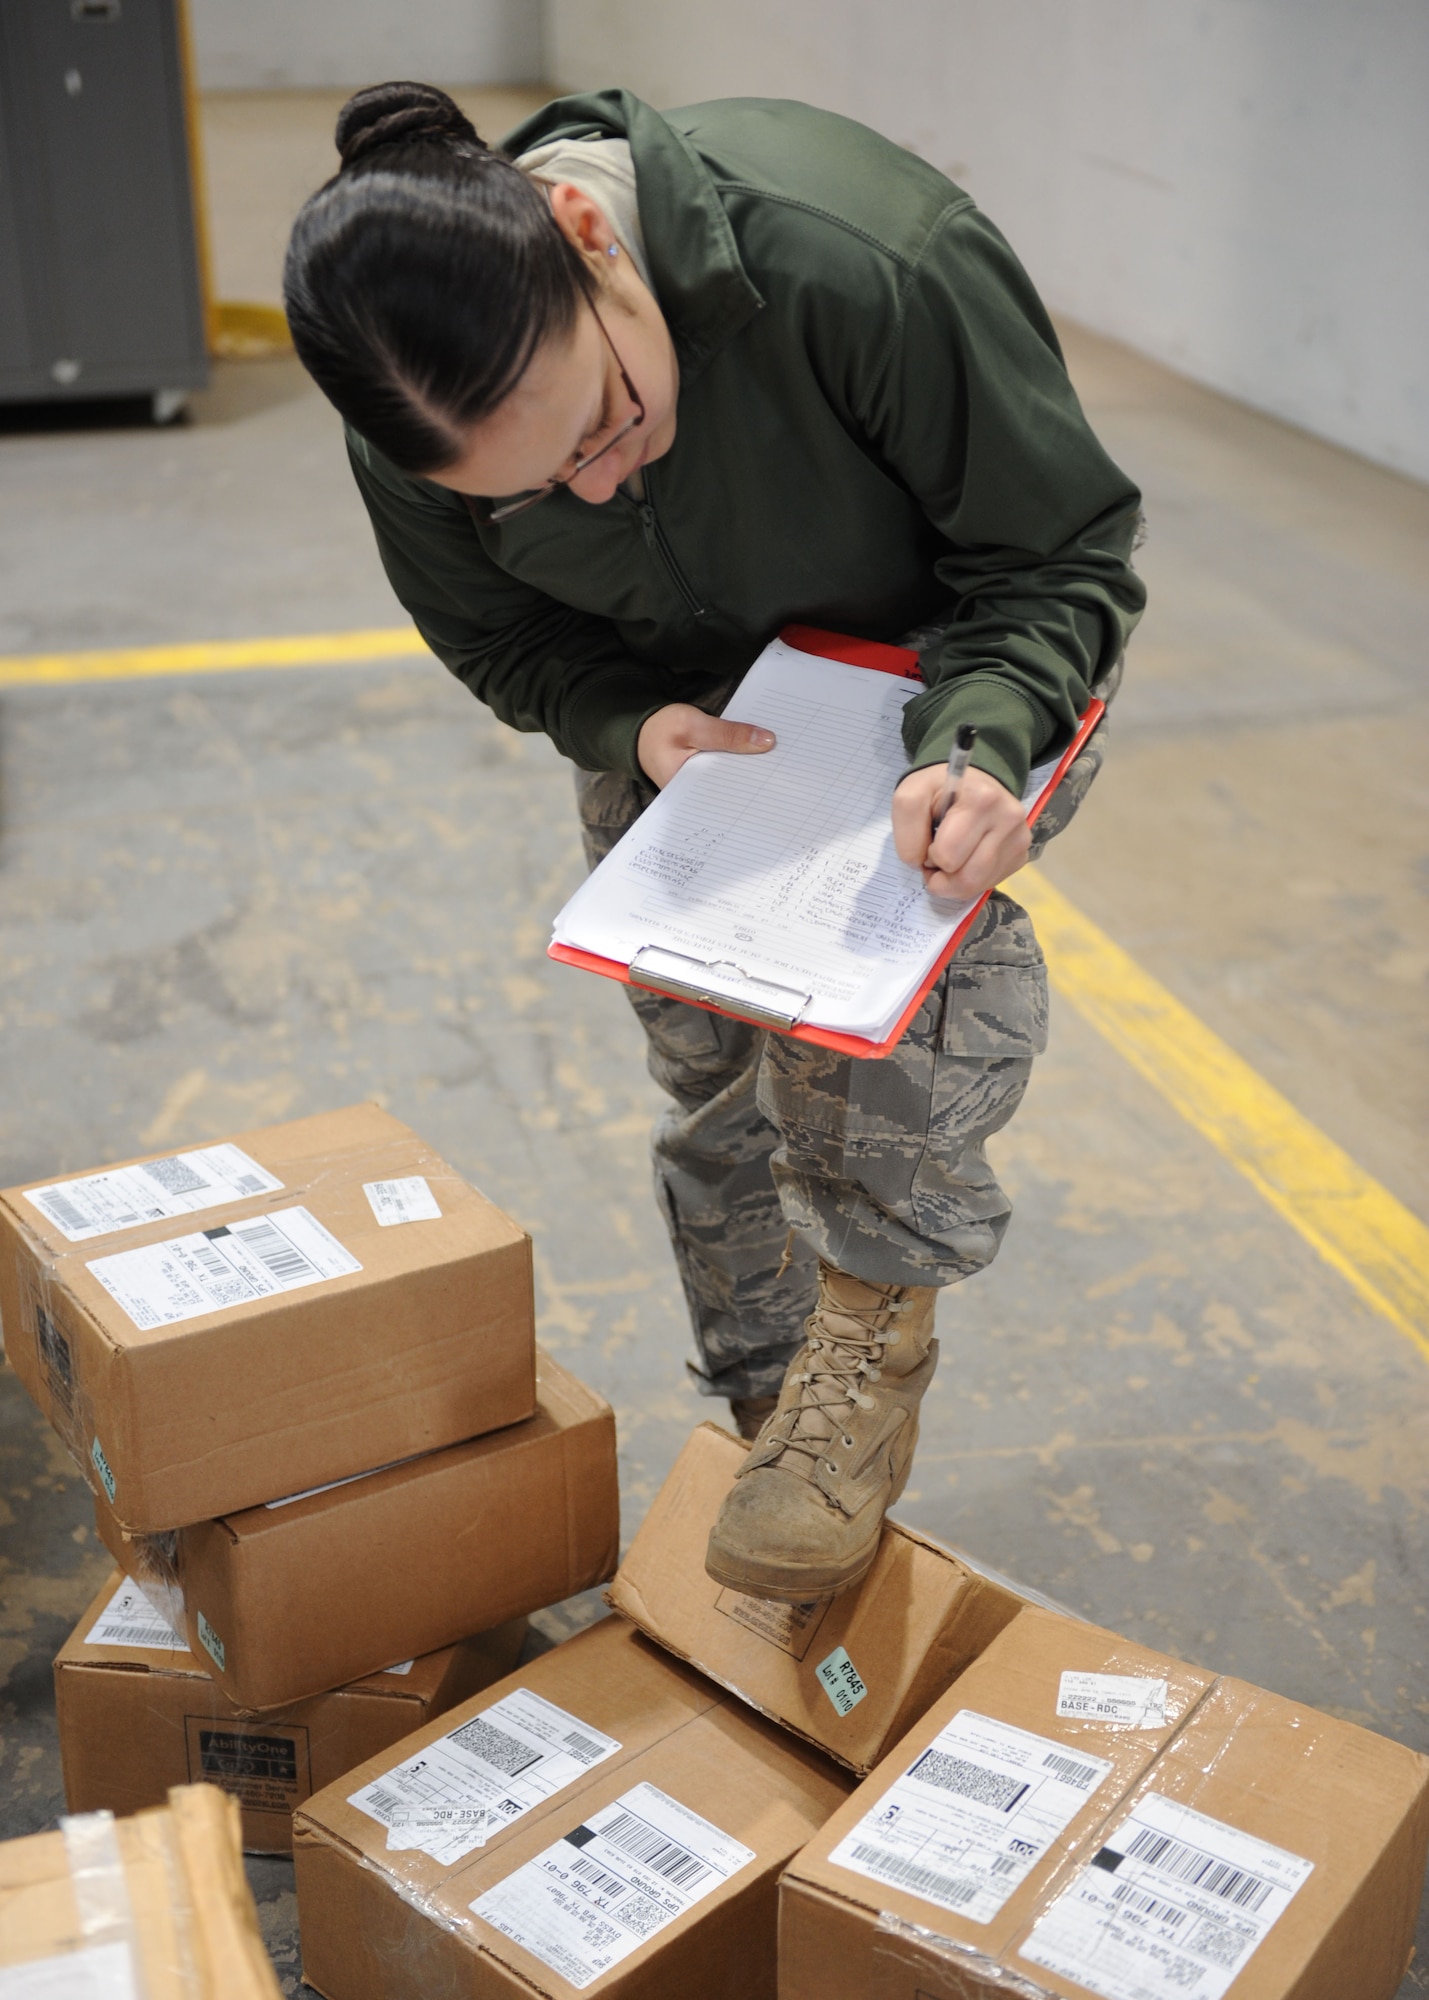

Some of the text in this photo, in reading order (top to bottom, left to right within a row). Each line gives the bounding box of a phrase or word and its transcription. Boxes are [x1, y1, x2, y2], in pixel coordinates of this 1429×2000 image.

[822, 1664, 835, 1681] Lot
[839, 1661, 864, 1695] R7845
[1061, 1700, 1118, 1714] BASE-RDC
[208, 1739, 288, 1756] AbilityOne
[1054, 1772, 1090, 1790] FB4661
[433, 1809, 485, 1819] BASE-RDC
[498, 1799, 523, 1815] DOV
[1010, 1839, 1039, 1856] DOV
[542, 1860, 610, 1909] TX 796 0-01
[546, 1885, 569, 1901] 79607
[630, 1876, 680, 1911] UPS GROUND
[569, 1901, 581, 1909] TX
[582, 1909, 597, 1921] AFB
[1080, 1890, 1176, 1940] TX 796 0-01
[1186, 1901, 1257, 1937] UPS GROUND
[498, 1922, 513, 1934] LBS
[598, 1921, 622, 1939] DYESS
[513, 1934, 525, 1942] 33
[591, 1959, 606, 1969] SHIP
